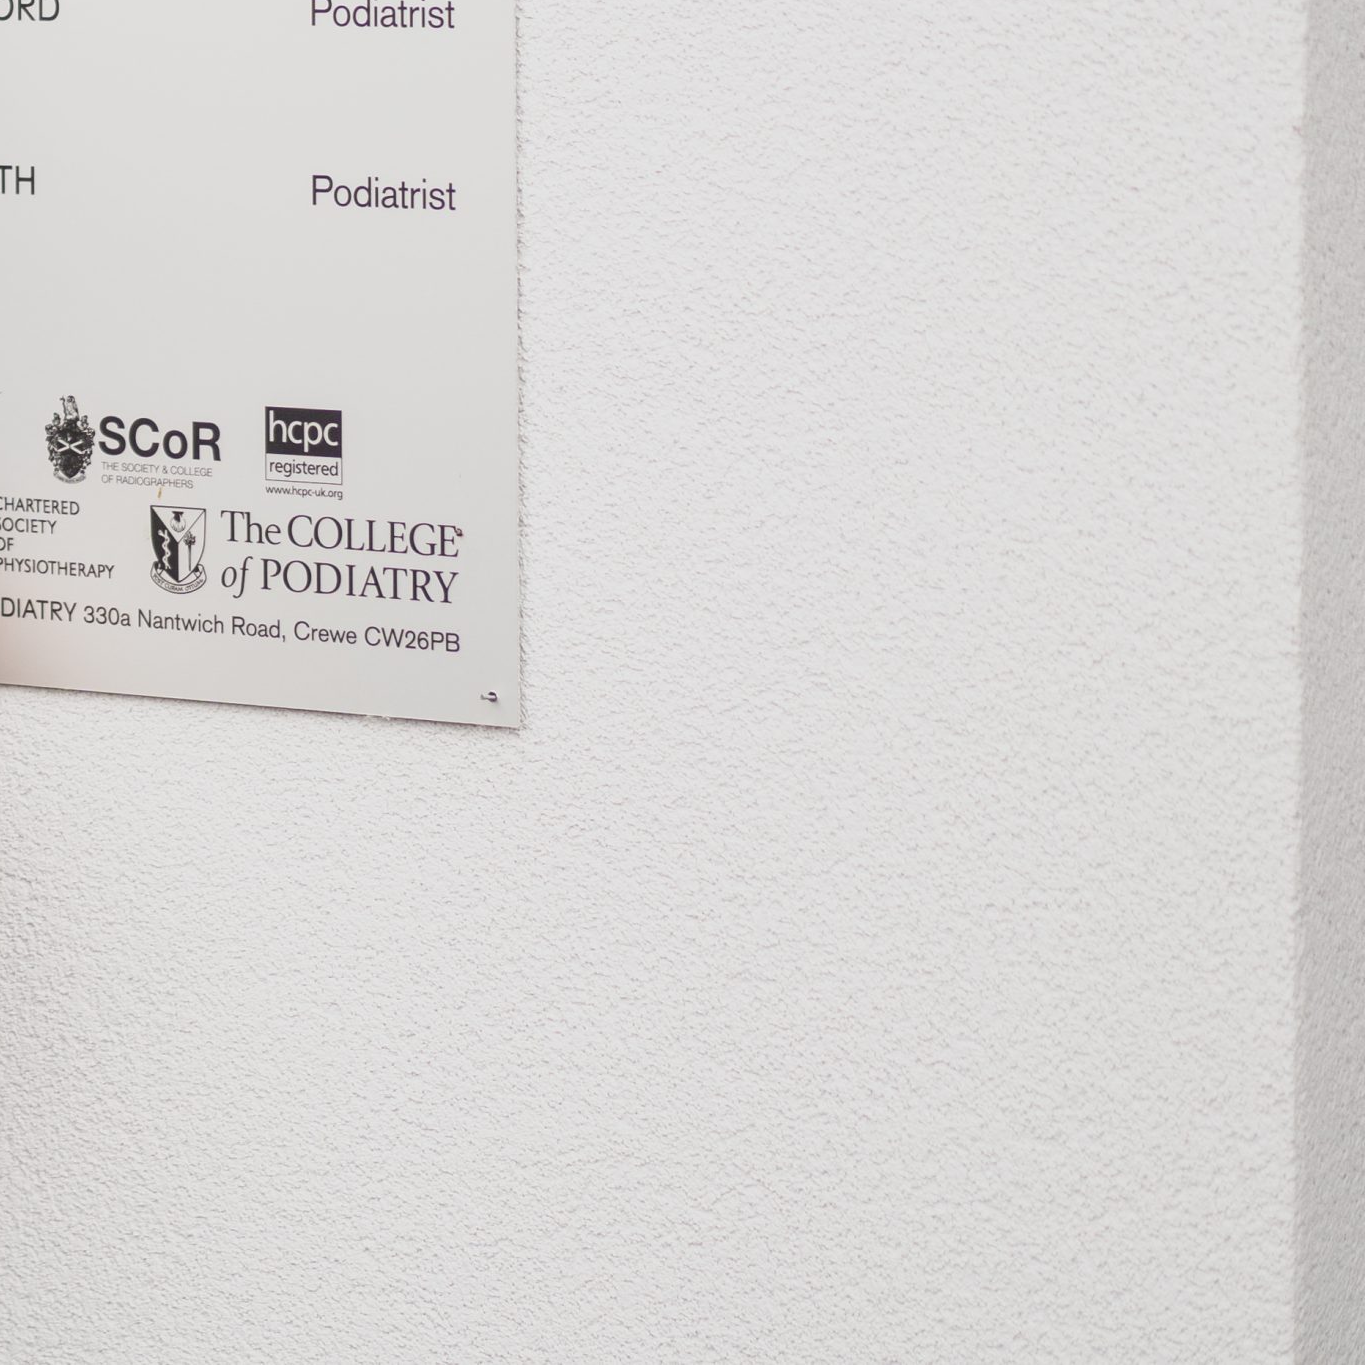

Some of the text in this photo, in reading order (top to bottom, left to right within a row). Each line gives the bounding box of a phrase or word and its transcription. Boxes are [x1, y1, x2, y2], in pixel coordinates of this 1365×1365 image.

[312, 174, 456, 211] Podiatrist
[98, 415, 222, 462] SCoR
[268, 409, 339, 453] hcpc
[101, 461, 213, 478] THE SOCIETY & COLLEGE
[101, 474, 114, 484] OF
[115, 473, 196, 490] RADIOGRAPHERS
[269, 459, 339, 478] registered
[265, 485, 344, 501] www.hcpc-uk.org
[220, 509, 459, 558] The COLLEGE
[220, 555, 459, 604] of PODIATRY
[83, 605, 132, 627] 330a
[138, 608, 224, 634] Nantwich
[231, 615, 286, 643] Road,
[293, 620, 358, 645] Crewe
[364, 626, 461, 653] CW26PB
